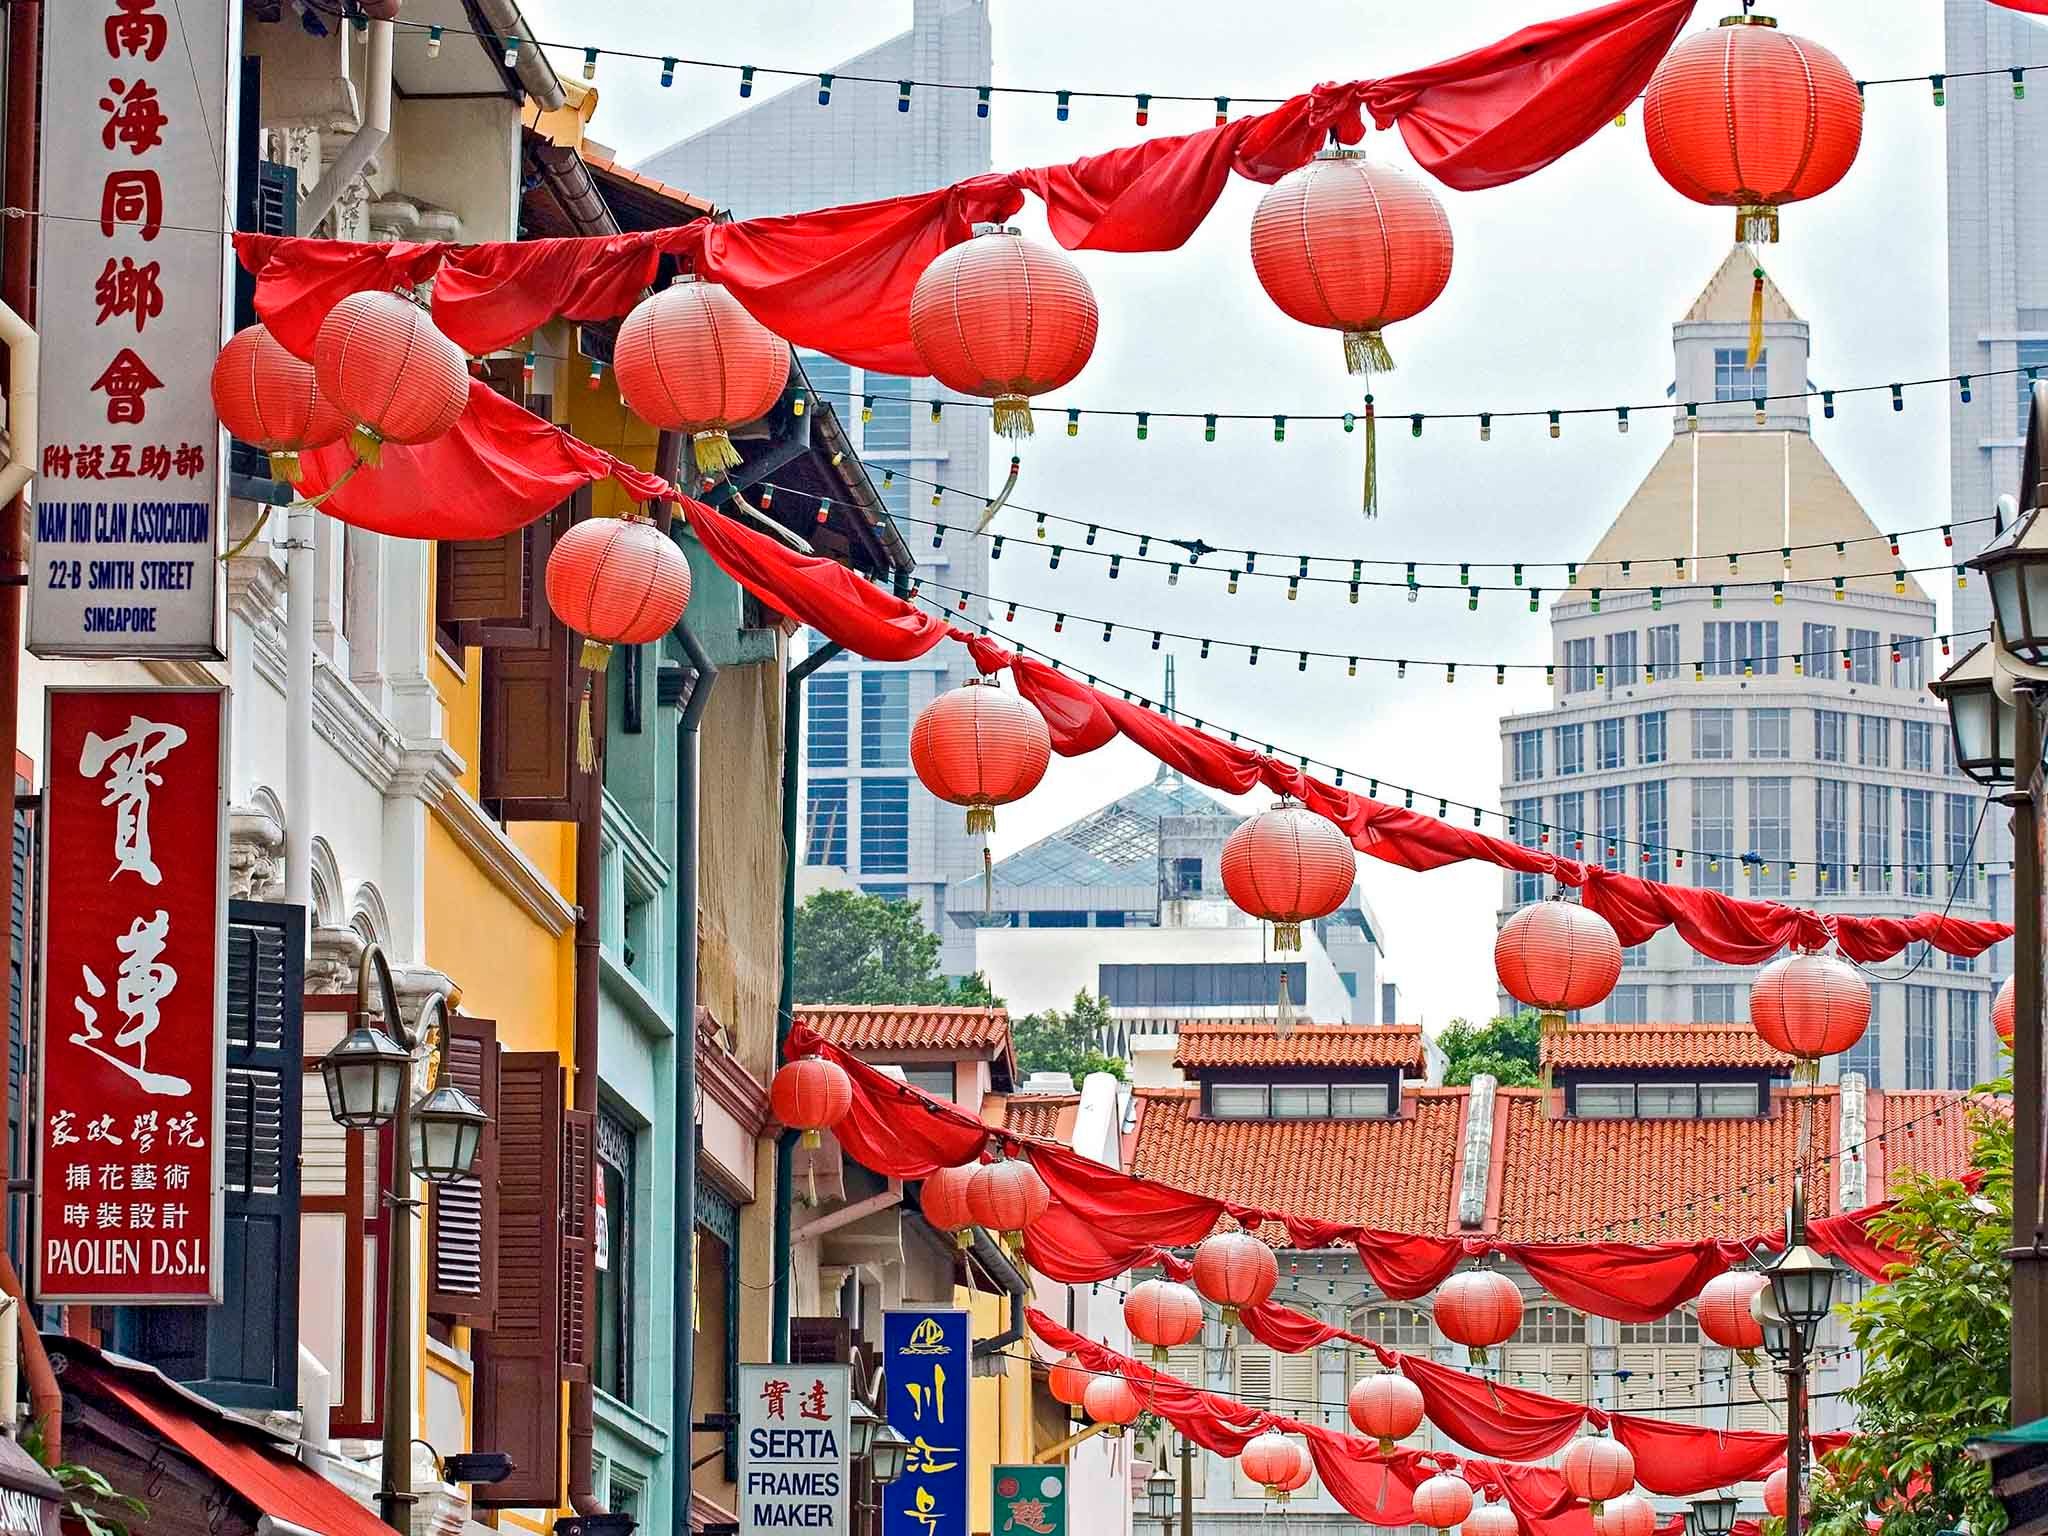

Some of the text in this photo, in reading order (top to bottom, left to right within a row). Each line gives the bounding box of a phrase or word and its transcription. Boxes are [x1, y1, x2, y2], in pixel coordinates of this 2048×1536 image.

[90, 0, 168, 424] 南海同鄉會
[42, 443, 205, 480] 附設互助部
[38, 502, 209, 543] NAM HOI CLAN ASSOCIATION
[48, 561, 194, 590] 22-B SMITH STREET
[84, 607, 157, 632] SINGAPORE
[49, 1109, 205, 1154] 家政學院
[47, 1239, 206, 1275] PAOLIEN D.S.I.
[749, 1427, 839, 1459] SERTA
[748, 1472, 840, 1497] FRAMES
[754, 1504, 834, 1527] MAKER
